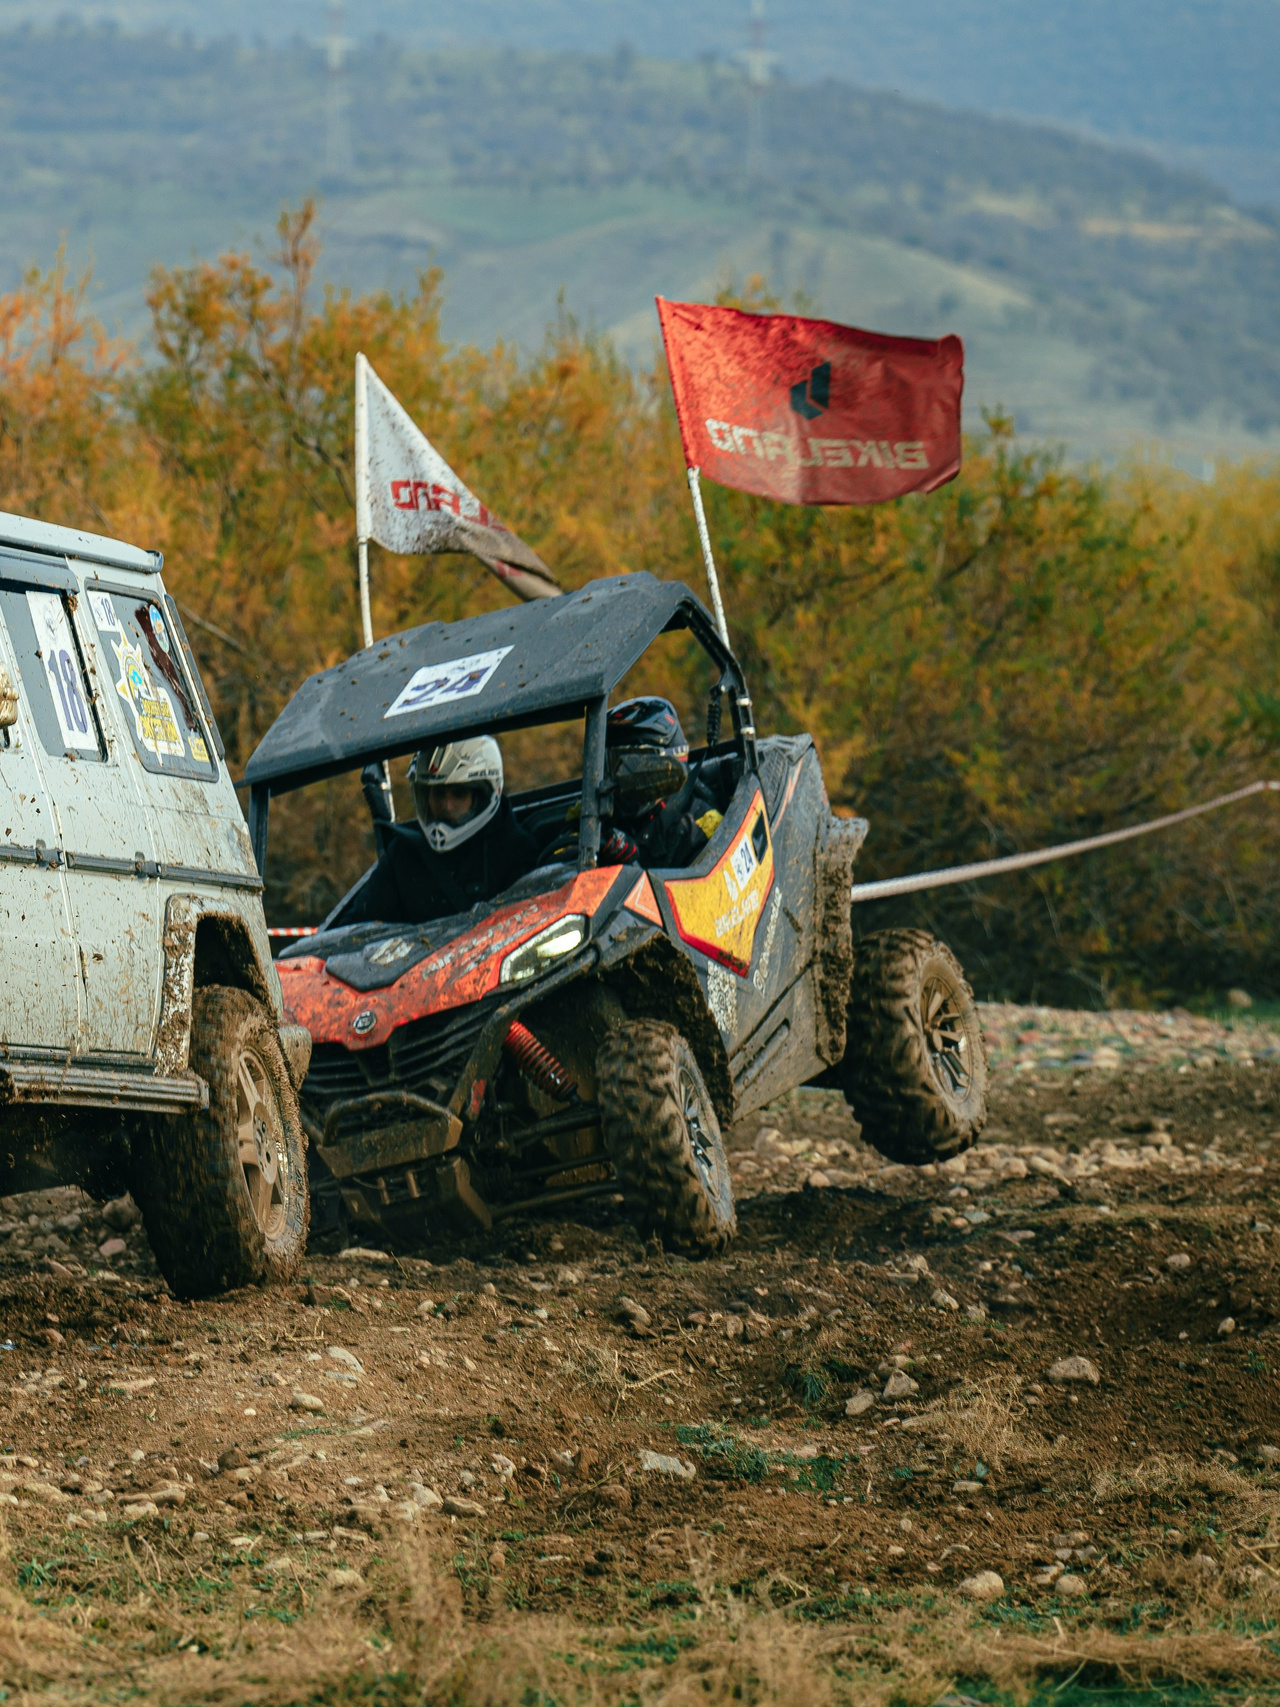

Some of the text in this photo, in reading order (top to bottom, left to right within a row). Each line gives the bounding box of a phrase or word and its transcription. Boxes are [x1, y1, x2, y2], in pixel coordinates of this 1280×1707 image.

[100, 598, 116, 626] 18
[48, 649, 88, 734] 18
[397, 665, 491, 709] 24
[740, 841, 754, 874] 24
